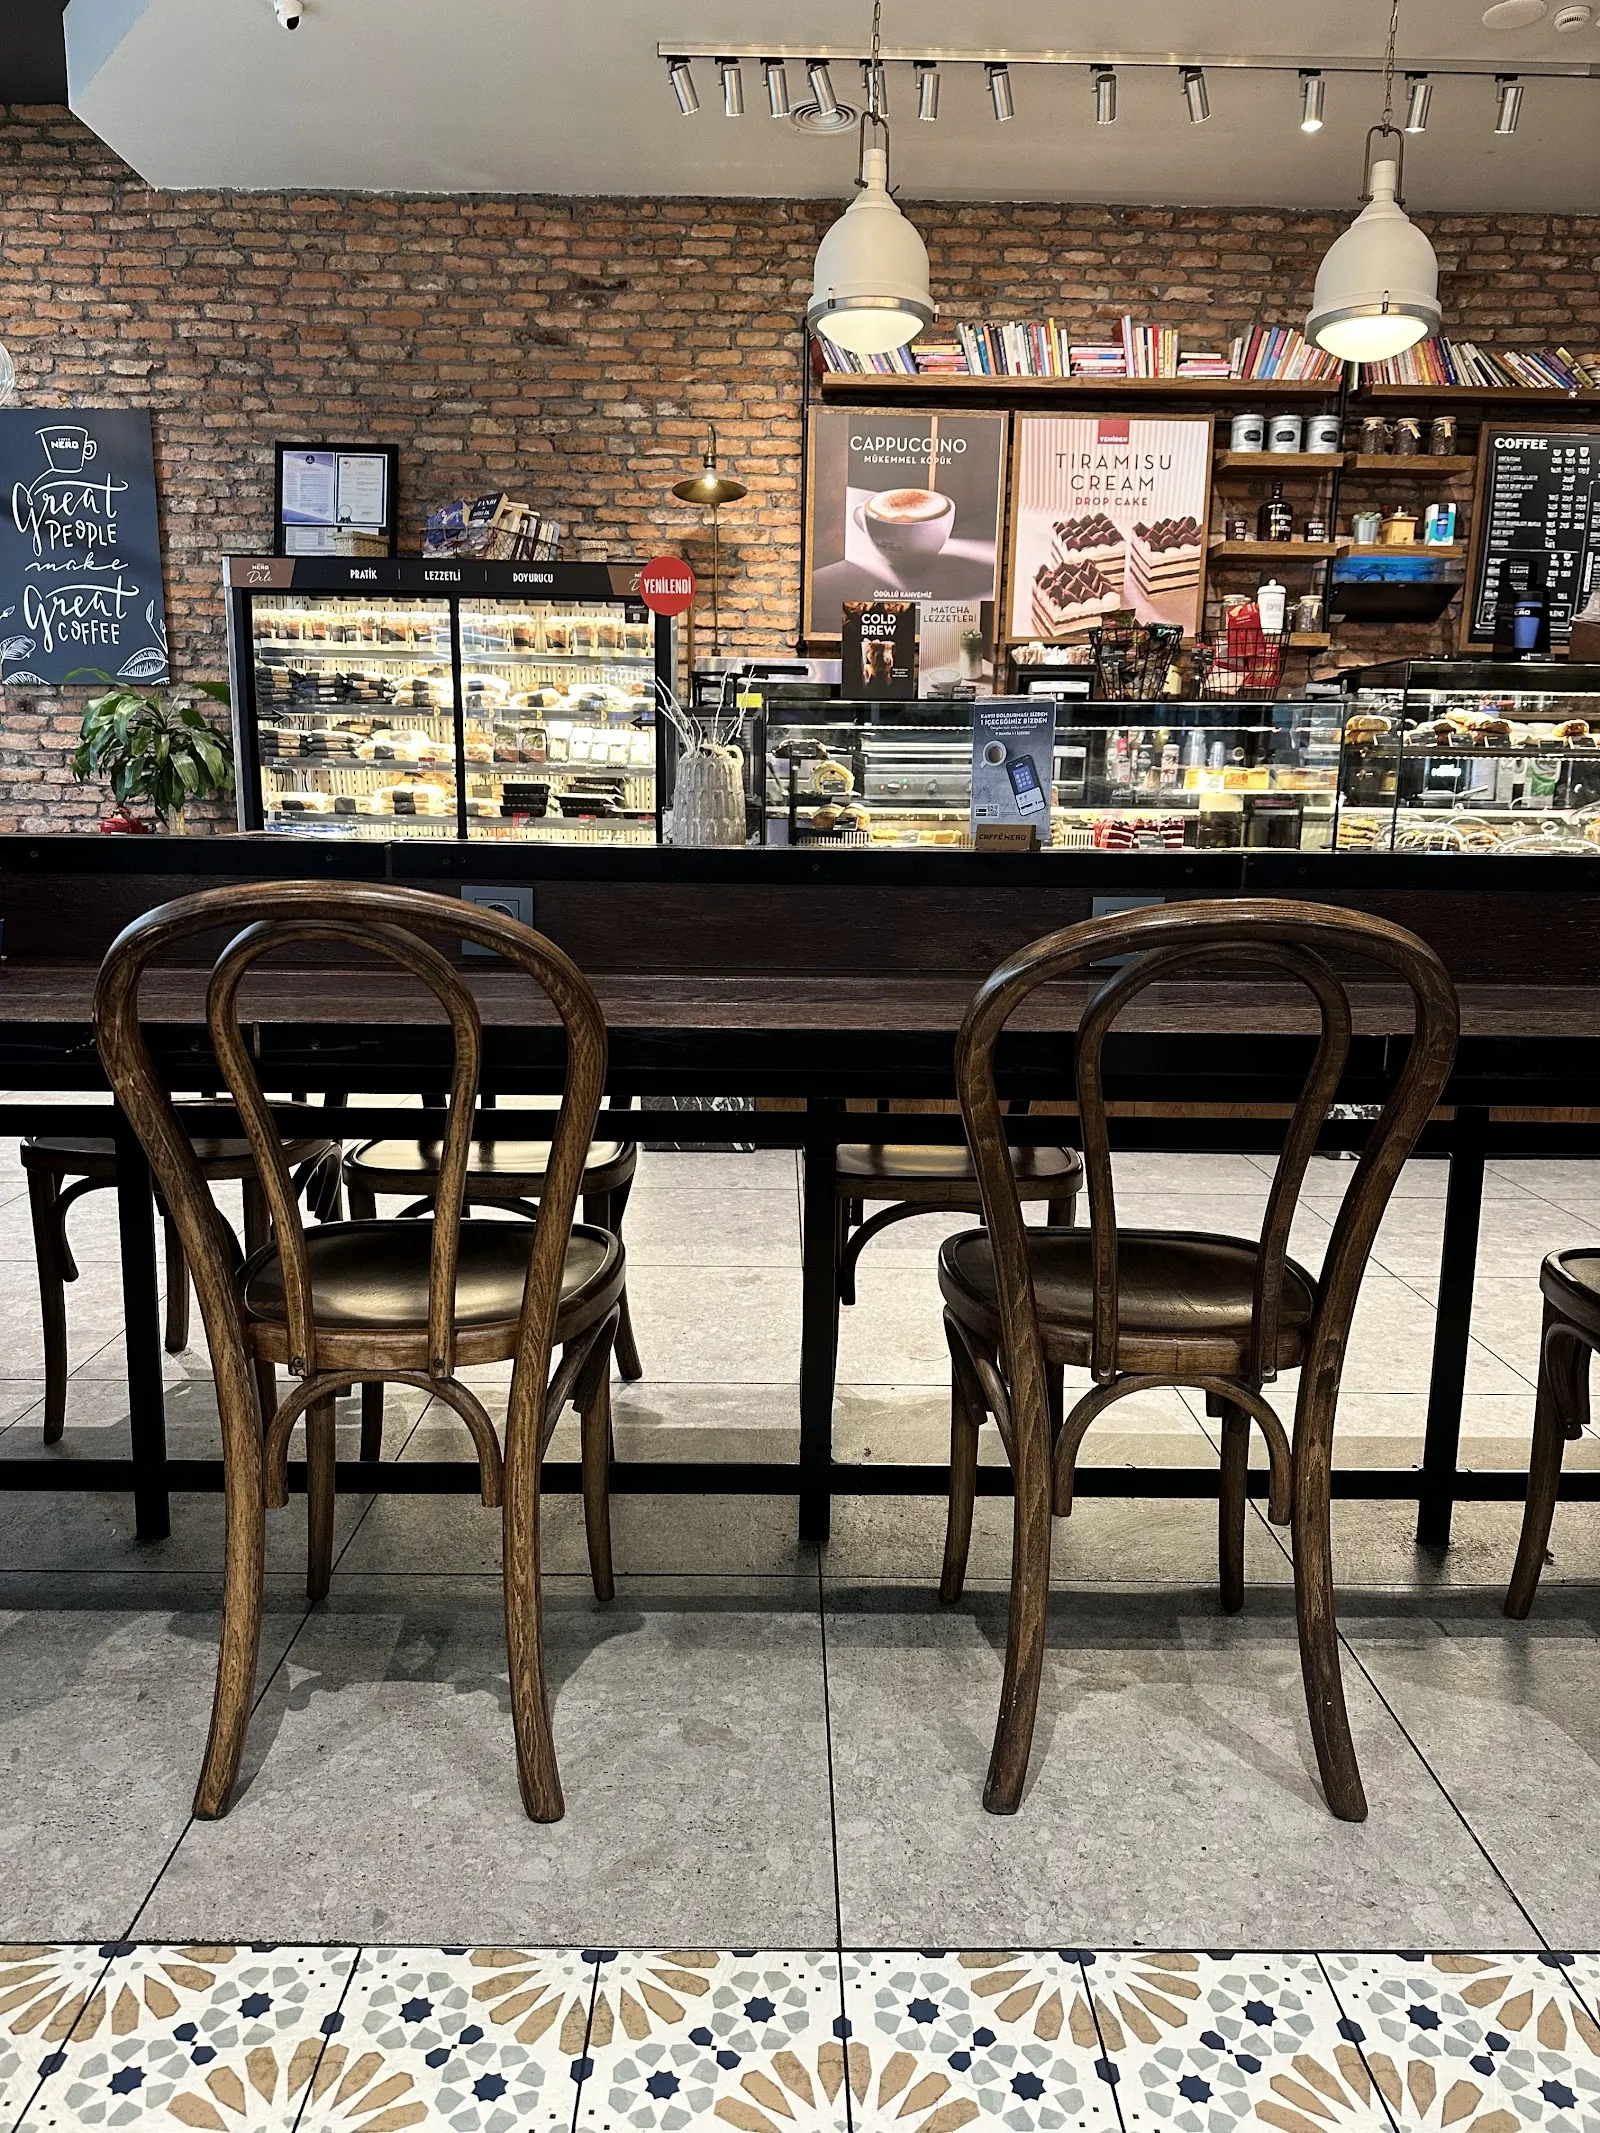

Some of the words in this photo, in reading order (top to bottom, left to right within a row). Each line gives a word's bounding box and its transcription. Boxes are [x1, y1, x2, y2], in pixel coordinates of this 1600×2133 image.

[50, 440, 79, 449] NERO
[849, 435, 967, 454] CAPPUCCINO
[1494, 437, 1549, 450] COFFEE
[864, 455, 916, 465] MÜKEMMEL
[1055, 453, 1172, 470] TIRAMISU
[1070, 474, 1154, 491] CREAM
[1075, 497, 1109, 506] DROP
[1114, 497, 1148, 506] CAKE
[12, 472, 129, 556] Great
[45, 519, 117, 550] PEOPLE
[25, 551, 129, 572] make
[350, 566, 378, 580] PRATİK
[424, 569, 461, 582] LEZZETLİ
[512, 572, 554, 583] DOYURUCU
[643, 576, 692, 594] YENİLENDİ
[873, 590, 899, 598] ÖDÜLLÜ
[24, 575, 140, 653] Great
[930, 606, 970, 614] MATCHA
[861, 613, 897, 625] COLD
[923, 614, 977, 623] LEZZETLERİ
[58, 619, 120, 645] COFFEE
[861, 625, 897, 636] BREW
[984, 717, 1022, 727] İÇECEĞİNİZ
[1023, 716, 1048, 724] BİZDEN
